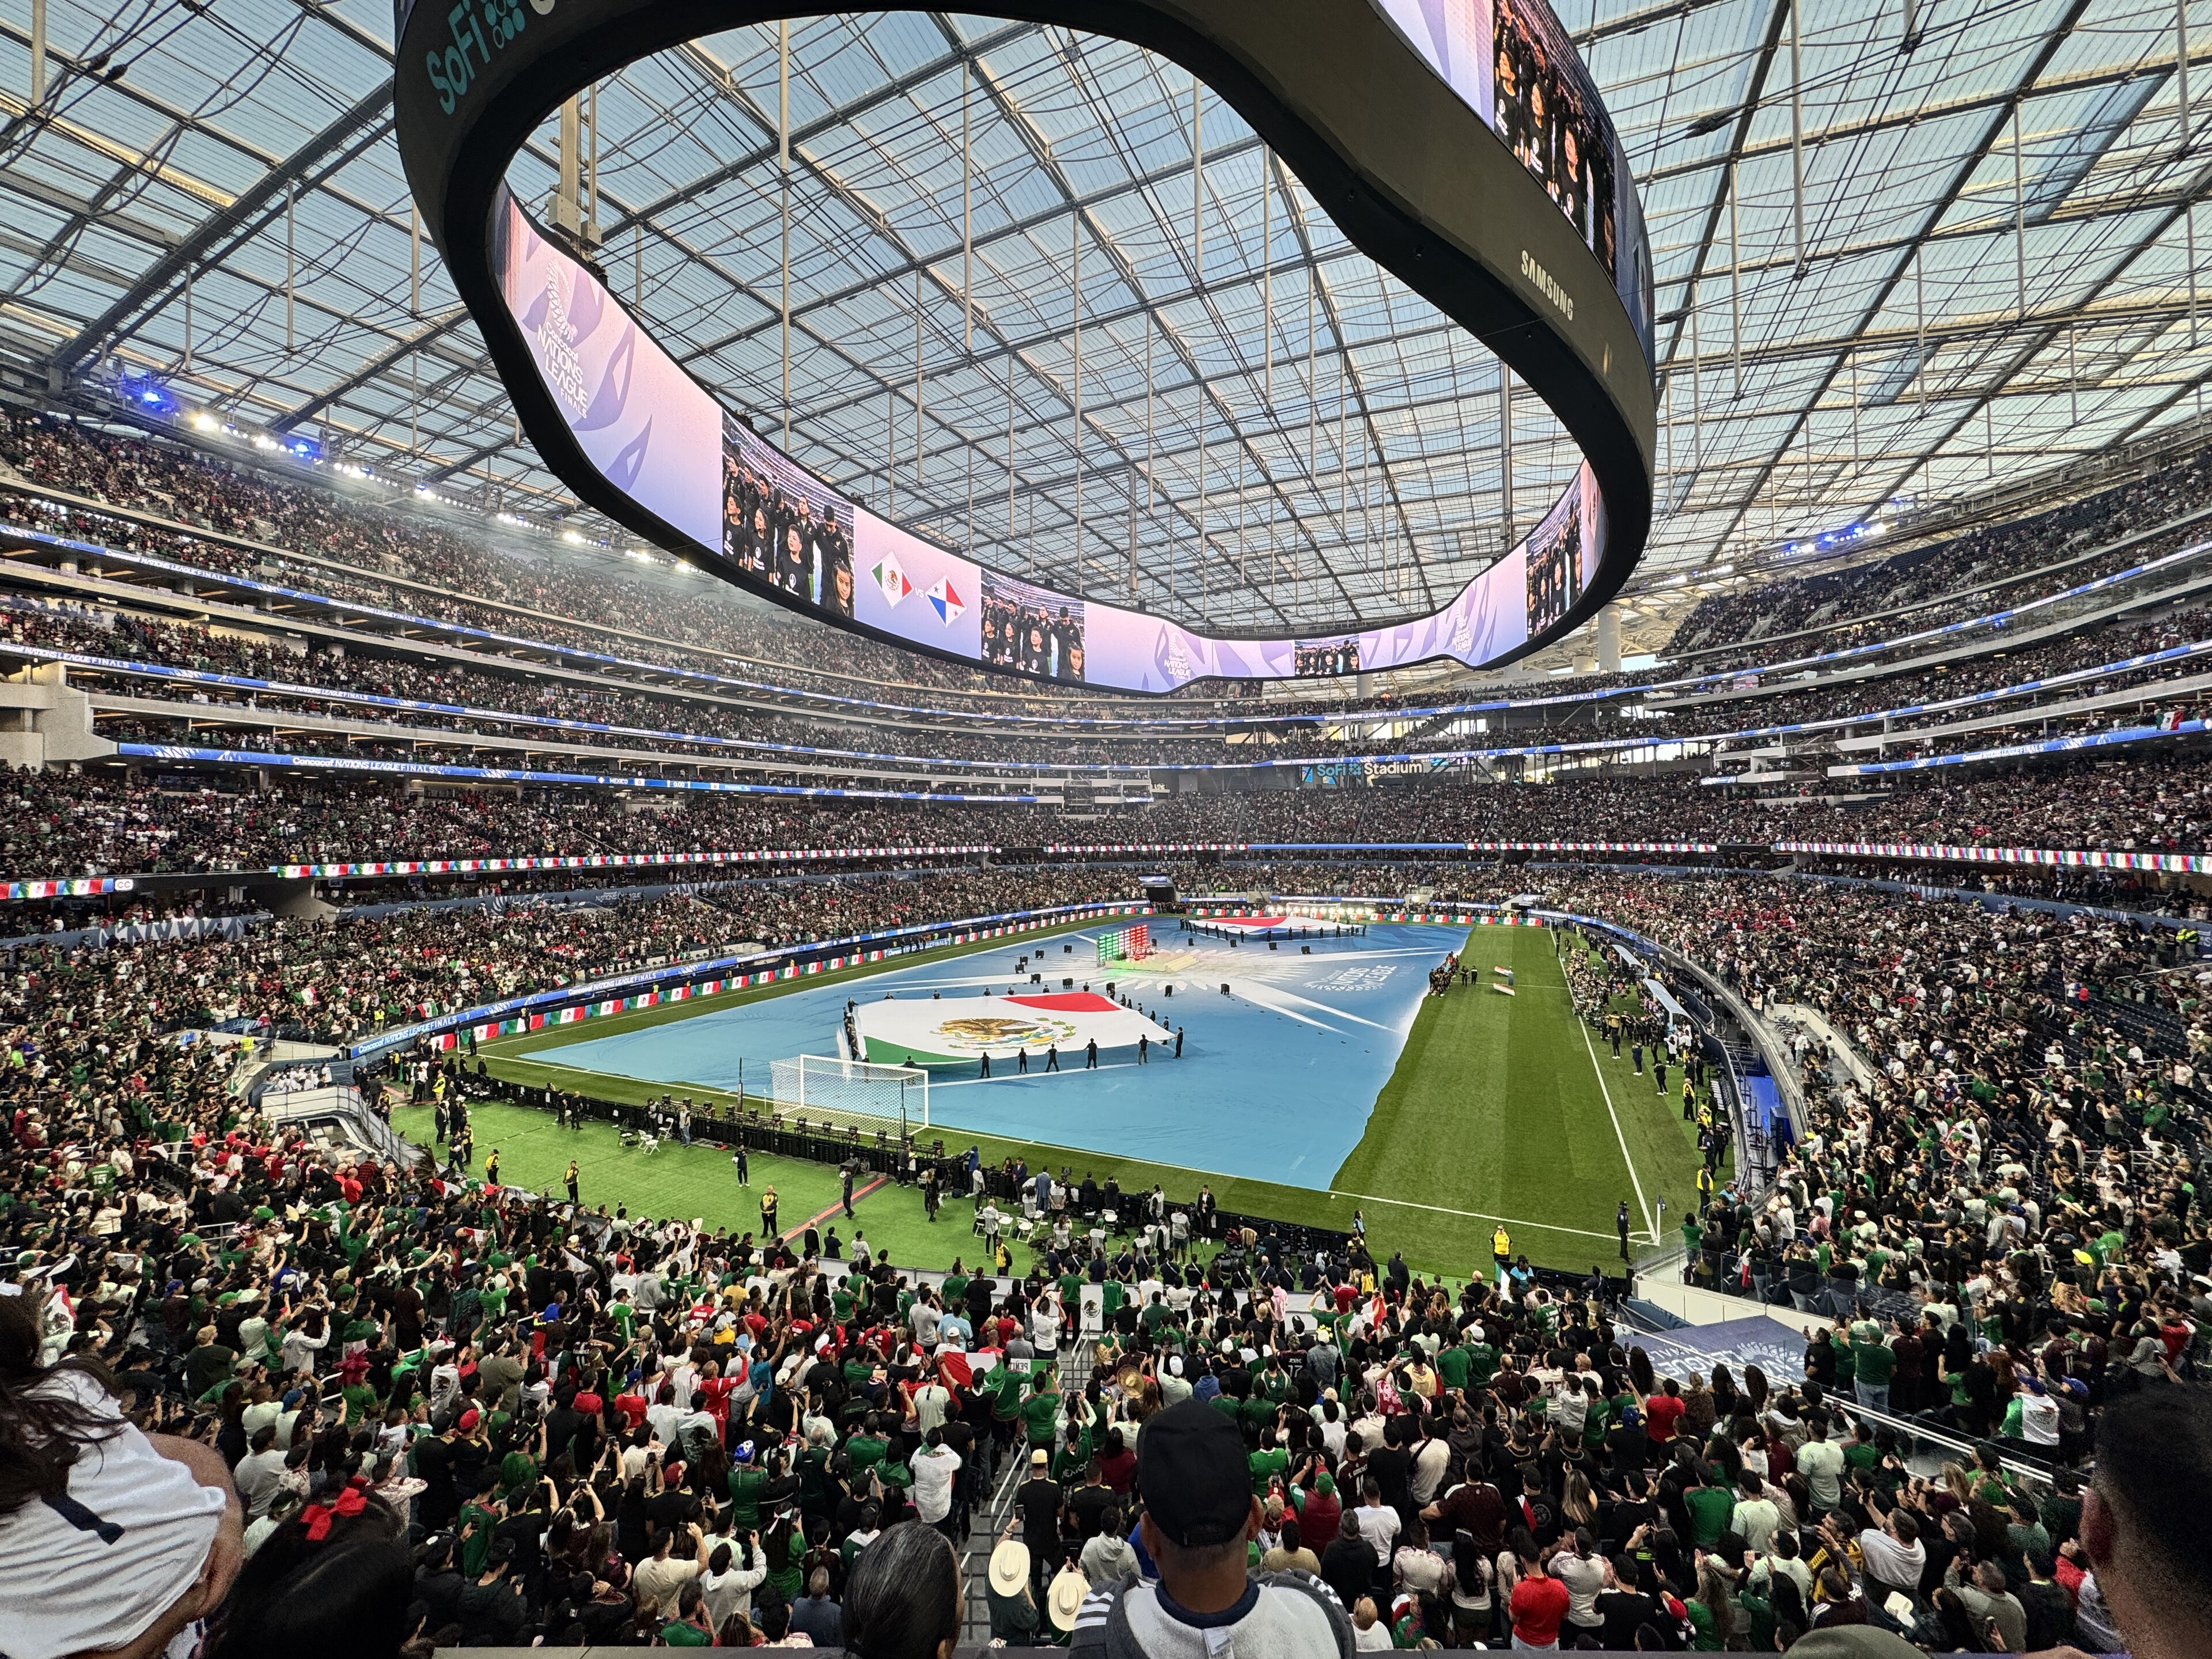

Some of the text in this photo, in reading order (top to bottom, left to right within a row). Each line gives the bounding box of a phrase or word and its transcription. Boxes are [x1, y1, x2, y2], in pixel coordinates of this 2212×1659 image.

[426, 0, 490, 115] SoFi
[1521, 250, 1573, 321] SAMSUNG
[546, 321, 578, 362] Concacaf
[537, 324, 582, 384] NATIONS
[545, 353, 587, 408] LEAGUE
[560, 389, 587, 419] FINALS
[198, 570, 228, 582] FINALS
[92, 657, 129, 668] FINALS
[1164, 660, 1189, 669] NATIONS
[1168, 667, 1191, 676] LEAGUE
[343, 691, 368, 700] FINALS
[2020, 744, 2044, 753] FINALS
[292, 757, 434, 773] Concacaf NATIONS LEAGUE FINALS
[1317, 761, 1422, 777] SoFi Stadium
[615, 977, 634, 986] LEAGUE
[634, 973, 656, 983] FINALS
[358, 1016, 457, 1054] Concacaf NATIONS LEAGUE FINALS
[1288, 1365, 1303, 1378] 17
